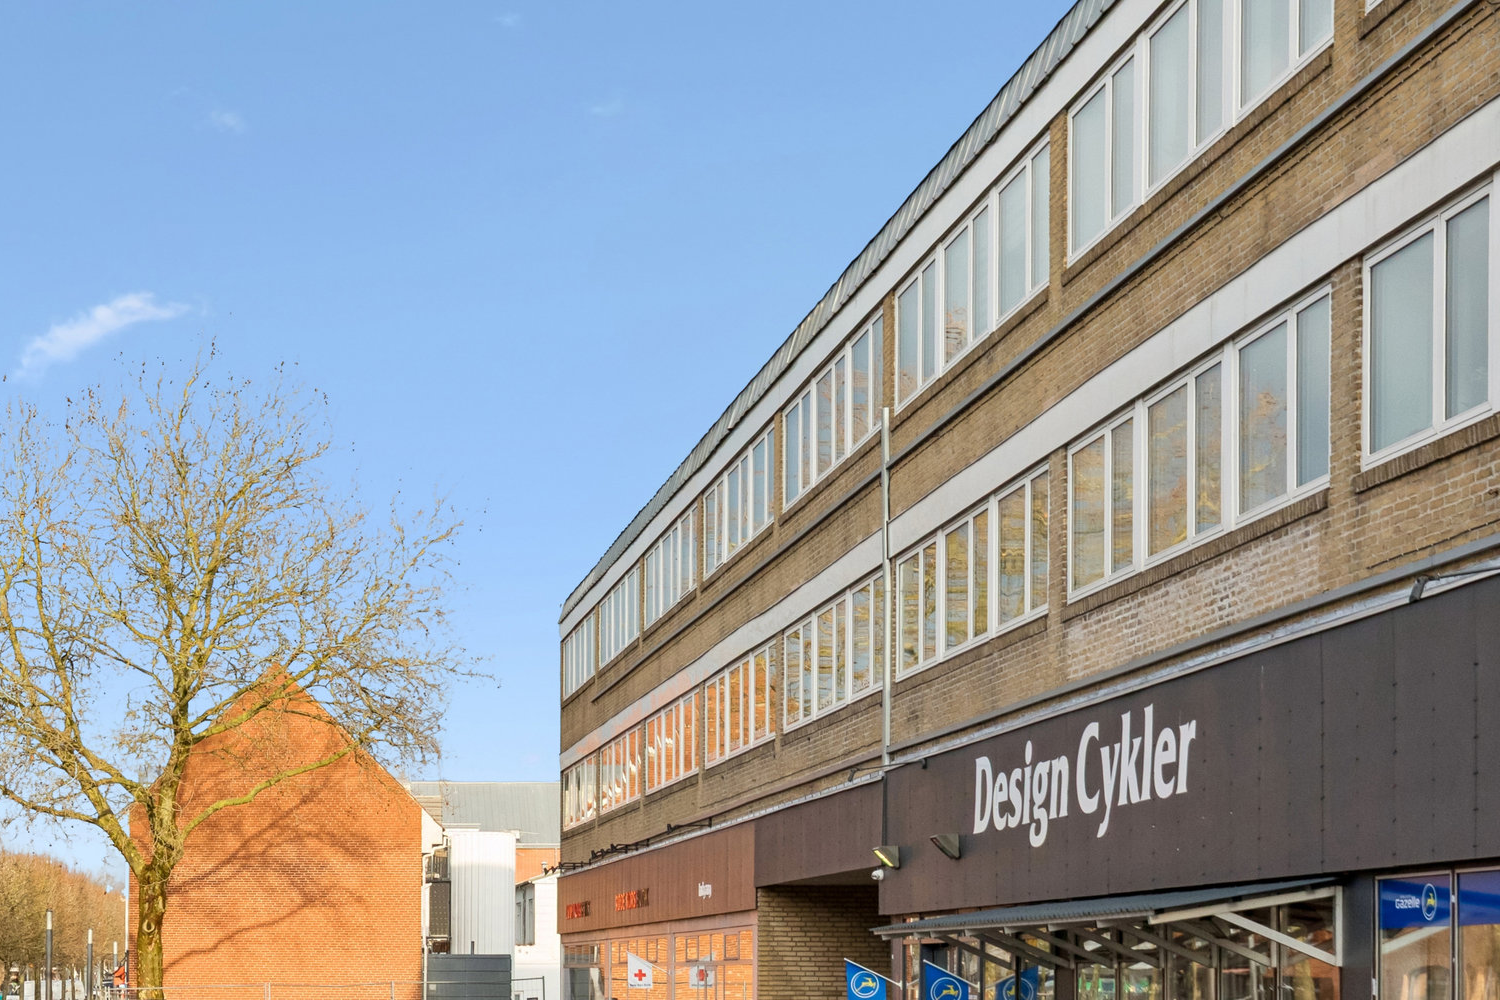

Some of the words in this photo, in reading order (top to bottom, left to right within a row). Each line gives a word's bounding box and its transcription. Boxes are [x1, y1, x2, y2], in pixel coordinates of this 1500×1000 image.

[973, 740, 1069, 848] Design
[1076, 703, 1197, 838] Cykler
[1395, 895, 1421, 909] Gazelle
